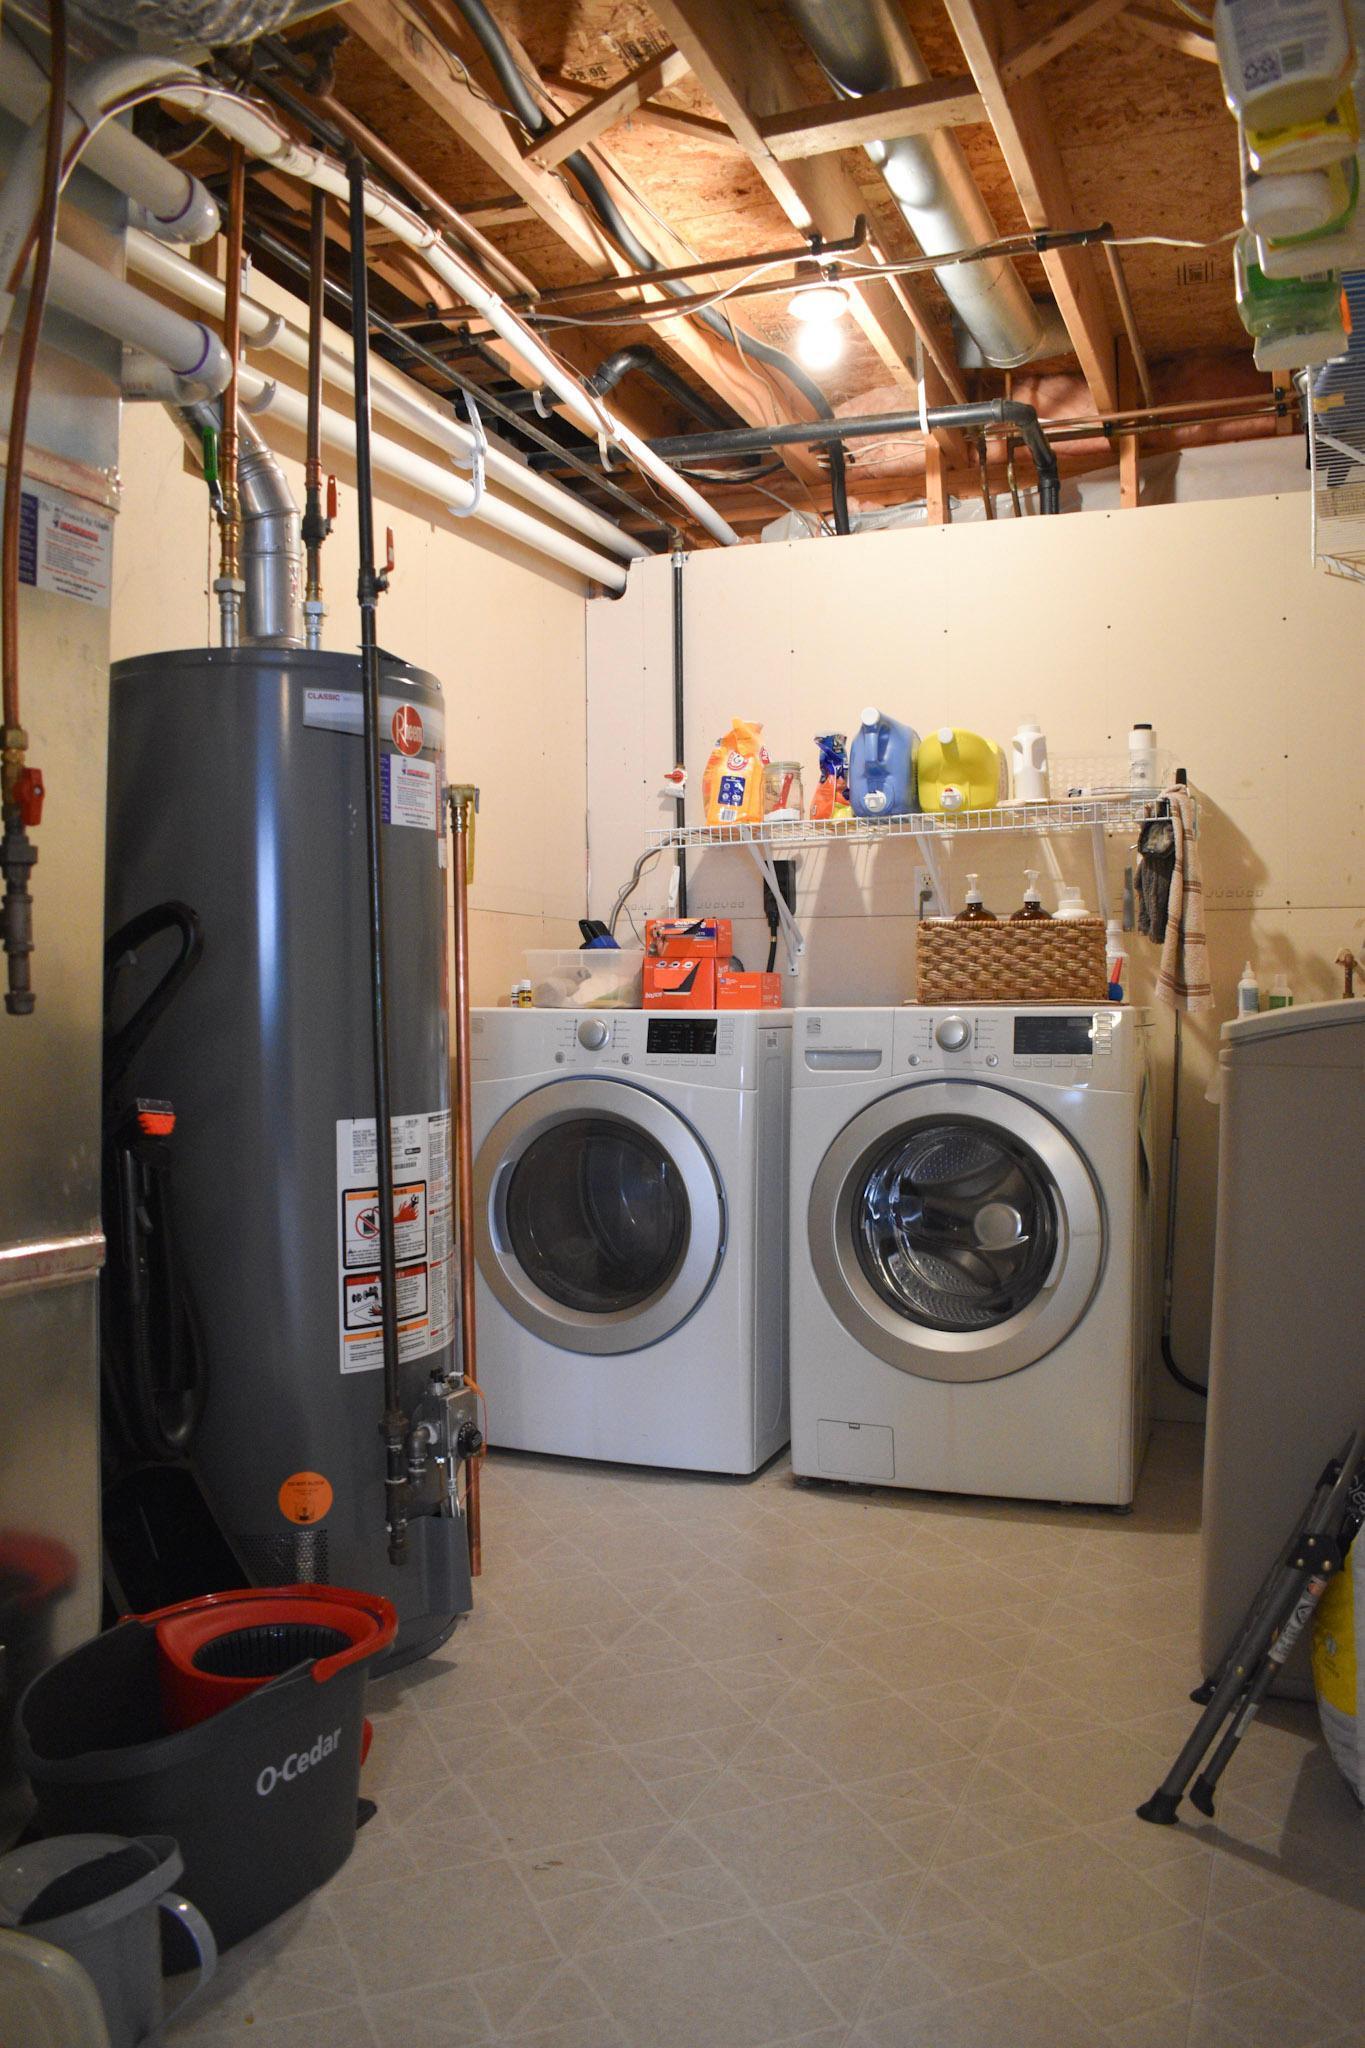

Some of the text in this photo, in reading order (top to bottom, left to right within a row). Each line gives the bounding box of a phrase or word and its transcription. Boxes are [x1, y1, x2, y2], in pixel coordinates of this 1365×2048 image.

[307, 692, 340, 701] CLASSIC
[395, 704, 423, 748] Rheem
[256, 1727, 342, 1796] O-Cedar
